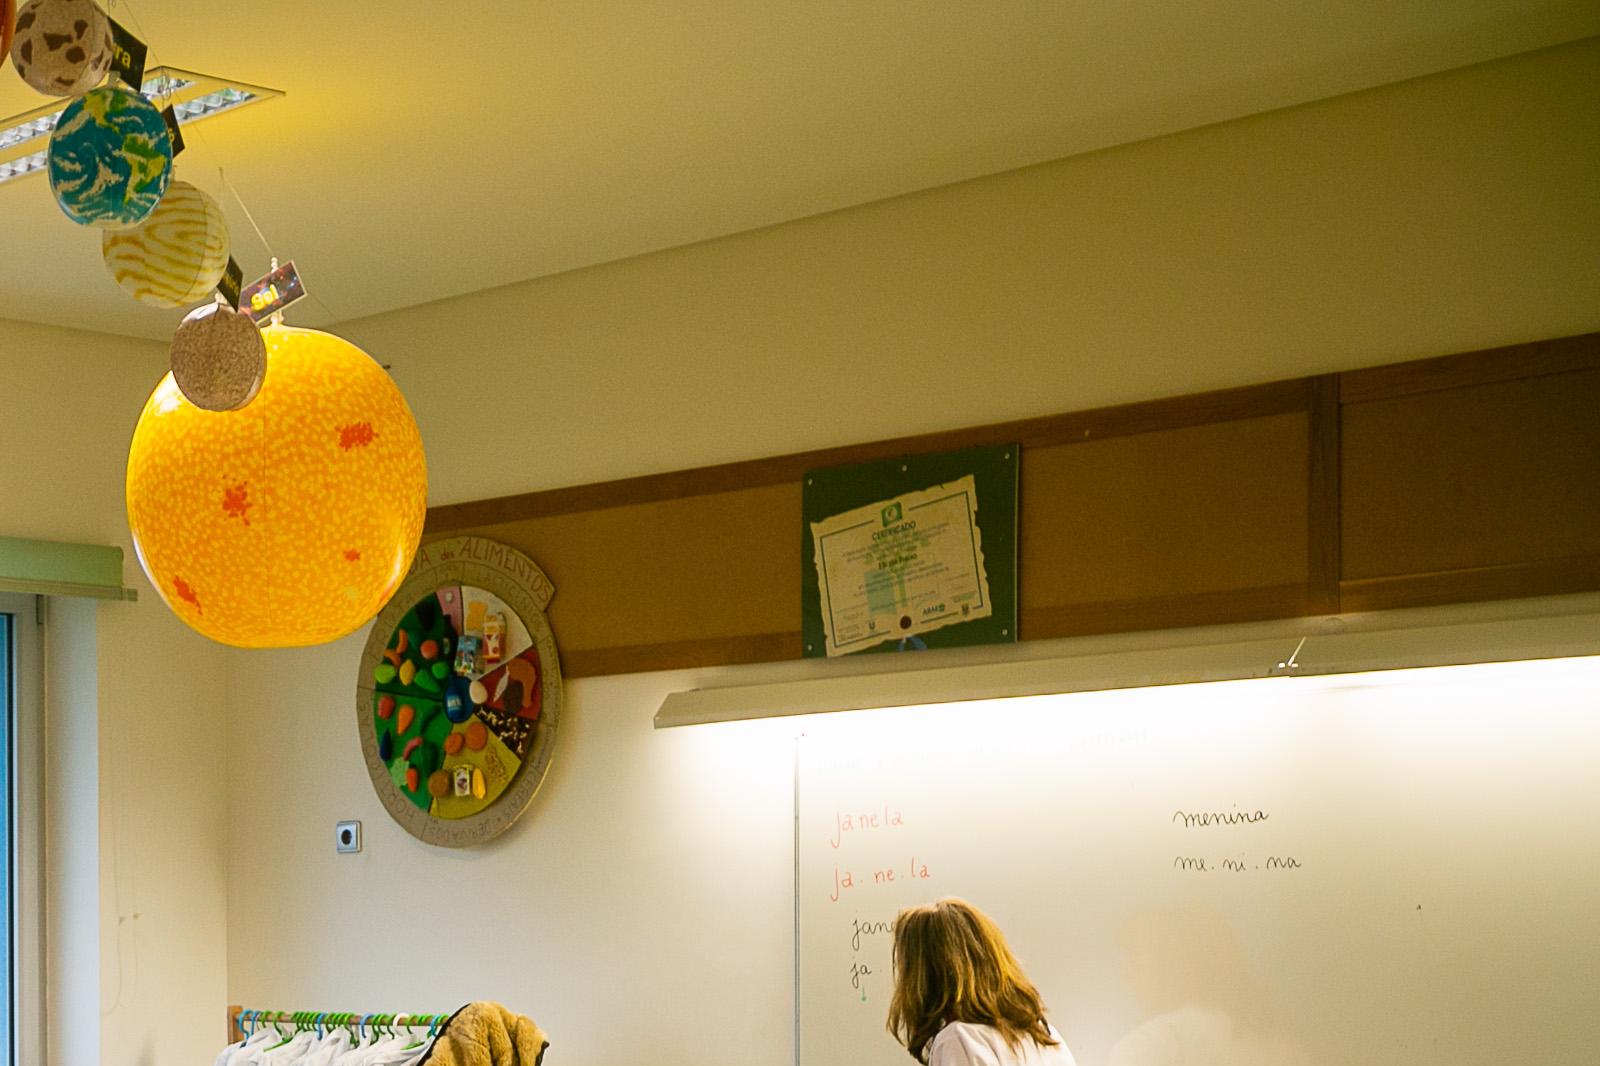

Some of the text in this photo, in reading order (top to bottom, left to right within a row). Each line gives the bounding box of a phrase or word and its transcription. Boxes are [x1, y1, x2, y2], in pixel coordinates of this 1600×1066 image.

[460, 536, 551, 600] ALIMENTOS
[831, 806, 903, 848] janela
[1173, 803, 1269, 828] menina
